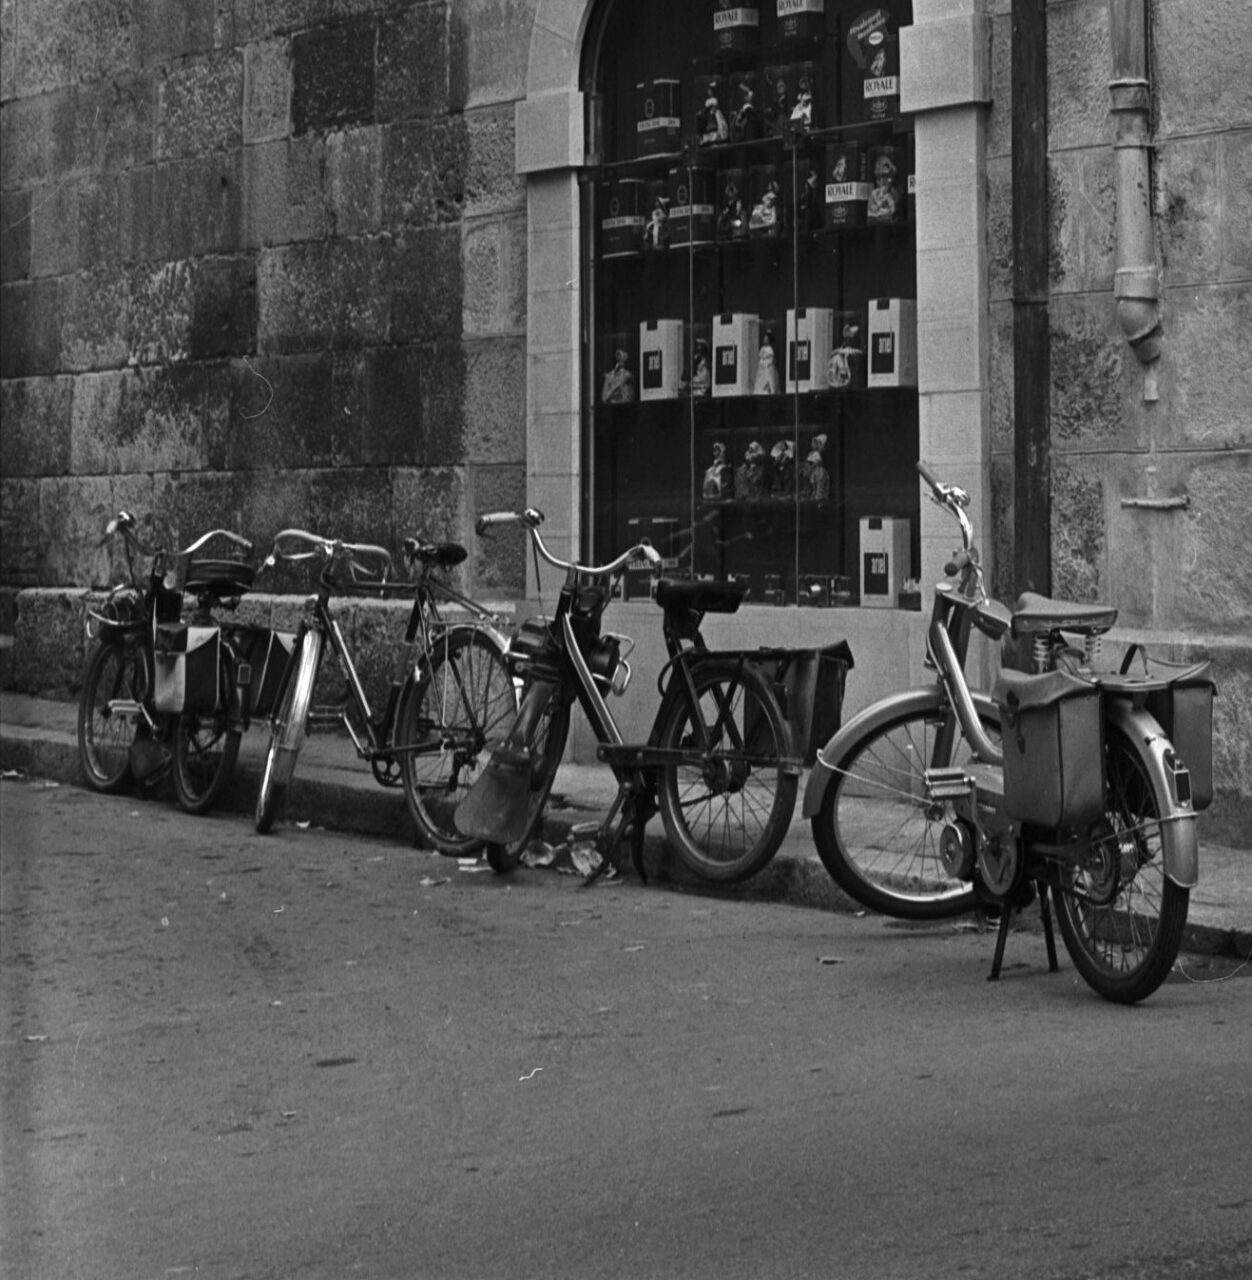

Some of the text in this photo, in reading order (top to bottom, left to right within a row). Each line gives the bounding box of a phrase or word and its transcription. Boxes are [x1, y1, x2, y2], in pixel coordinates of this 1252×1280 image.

[715, 9, 739, 24] ROYALE
[865, 78, 894, 92] ROYALE
[827, 184, 853, 197] ROYALE
